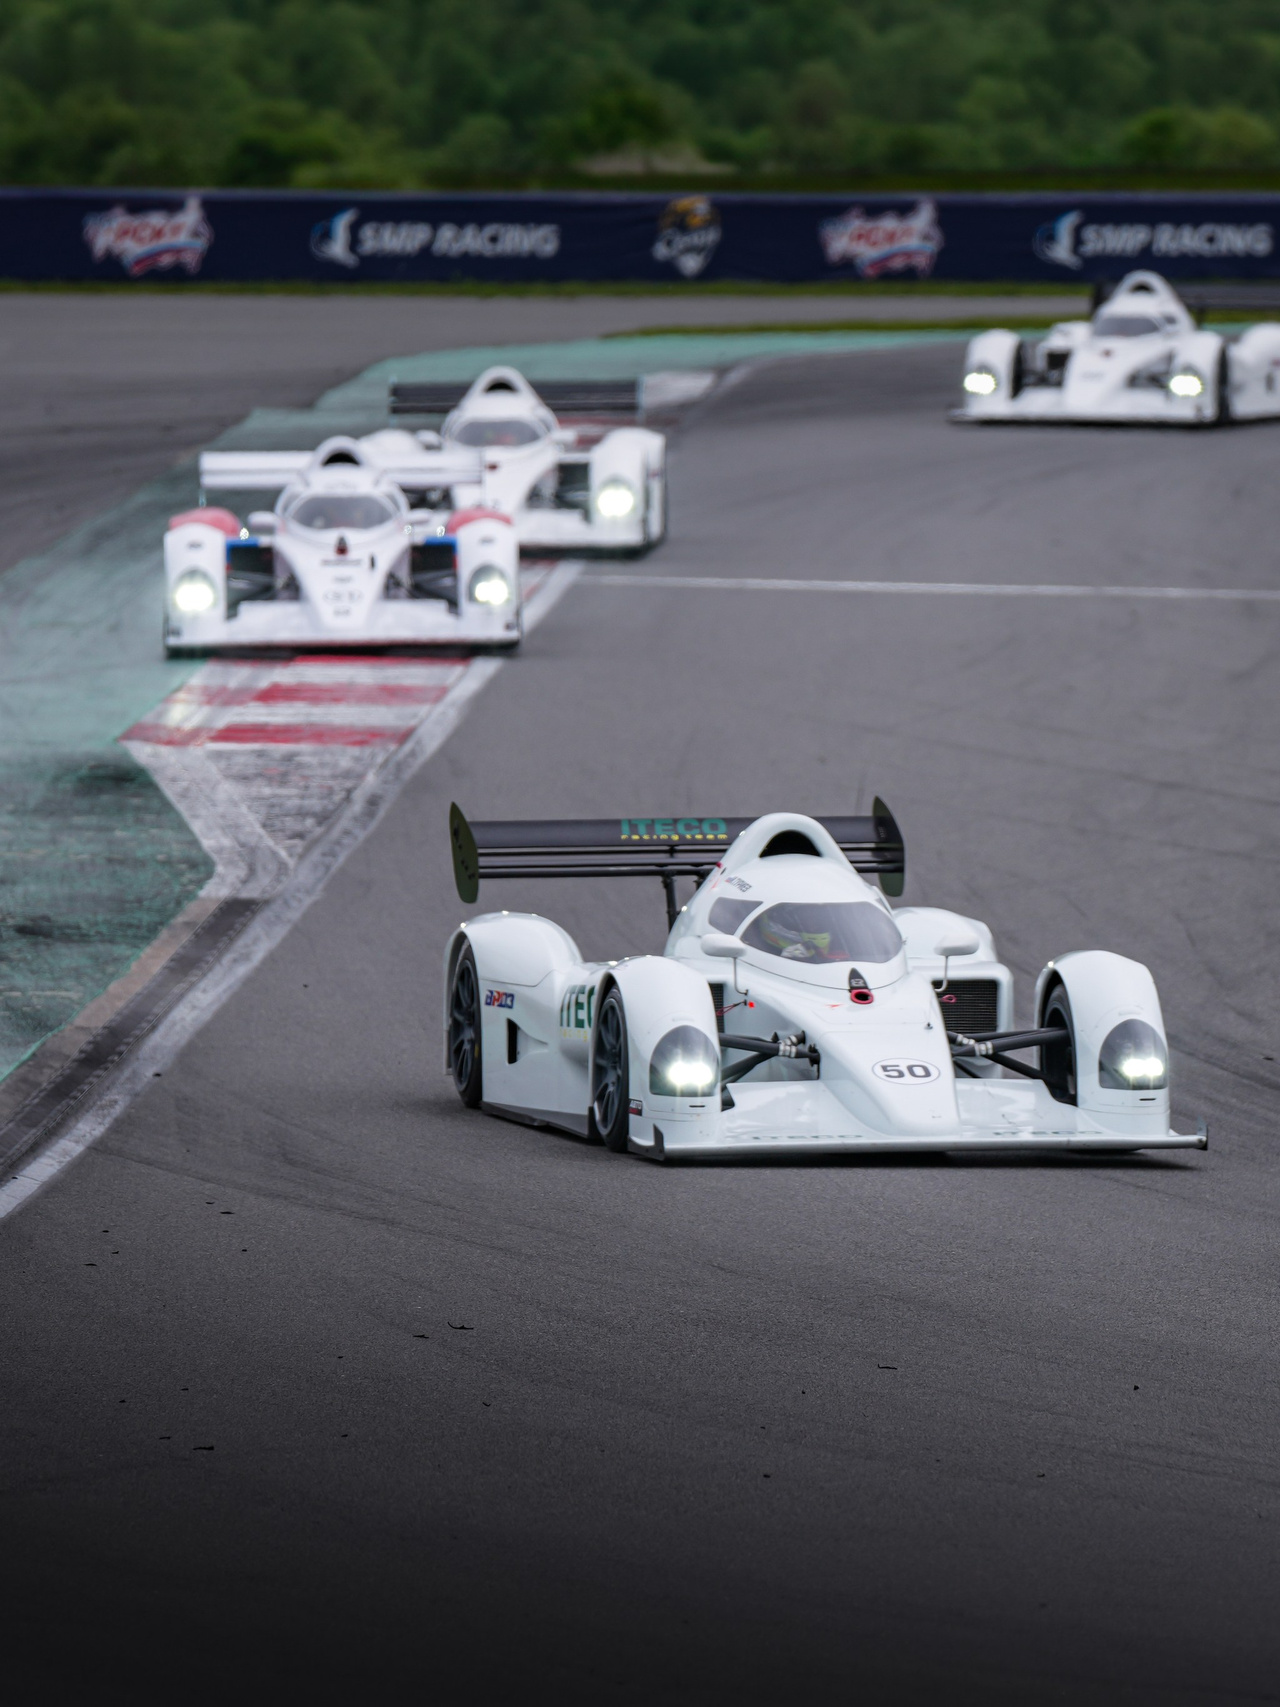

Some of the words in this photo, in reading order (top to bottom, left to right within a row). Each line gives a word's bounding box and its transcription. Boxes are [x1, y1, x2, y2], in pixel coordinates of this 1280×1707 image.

[357, 222, 432, 256] SMP
[433, 223, 560, 258] RACING
[1080, 223, 1151, 256] SMP
[1152, 223, 1273, 258] RACING
[620, 818, 728, 836] ITECO
[881, 1064, 932, 1079] 50
